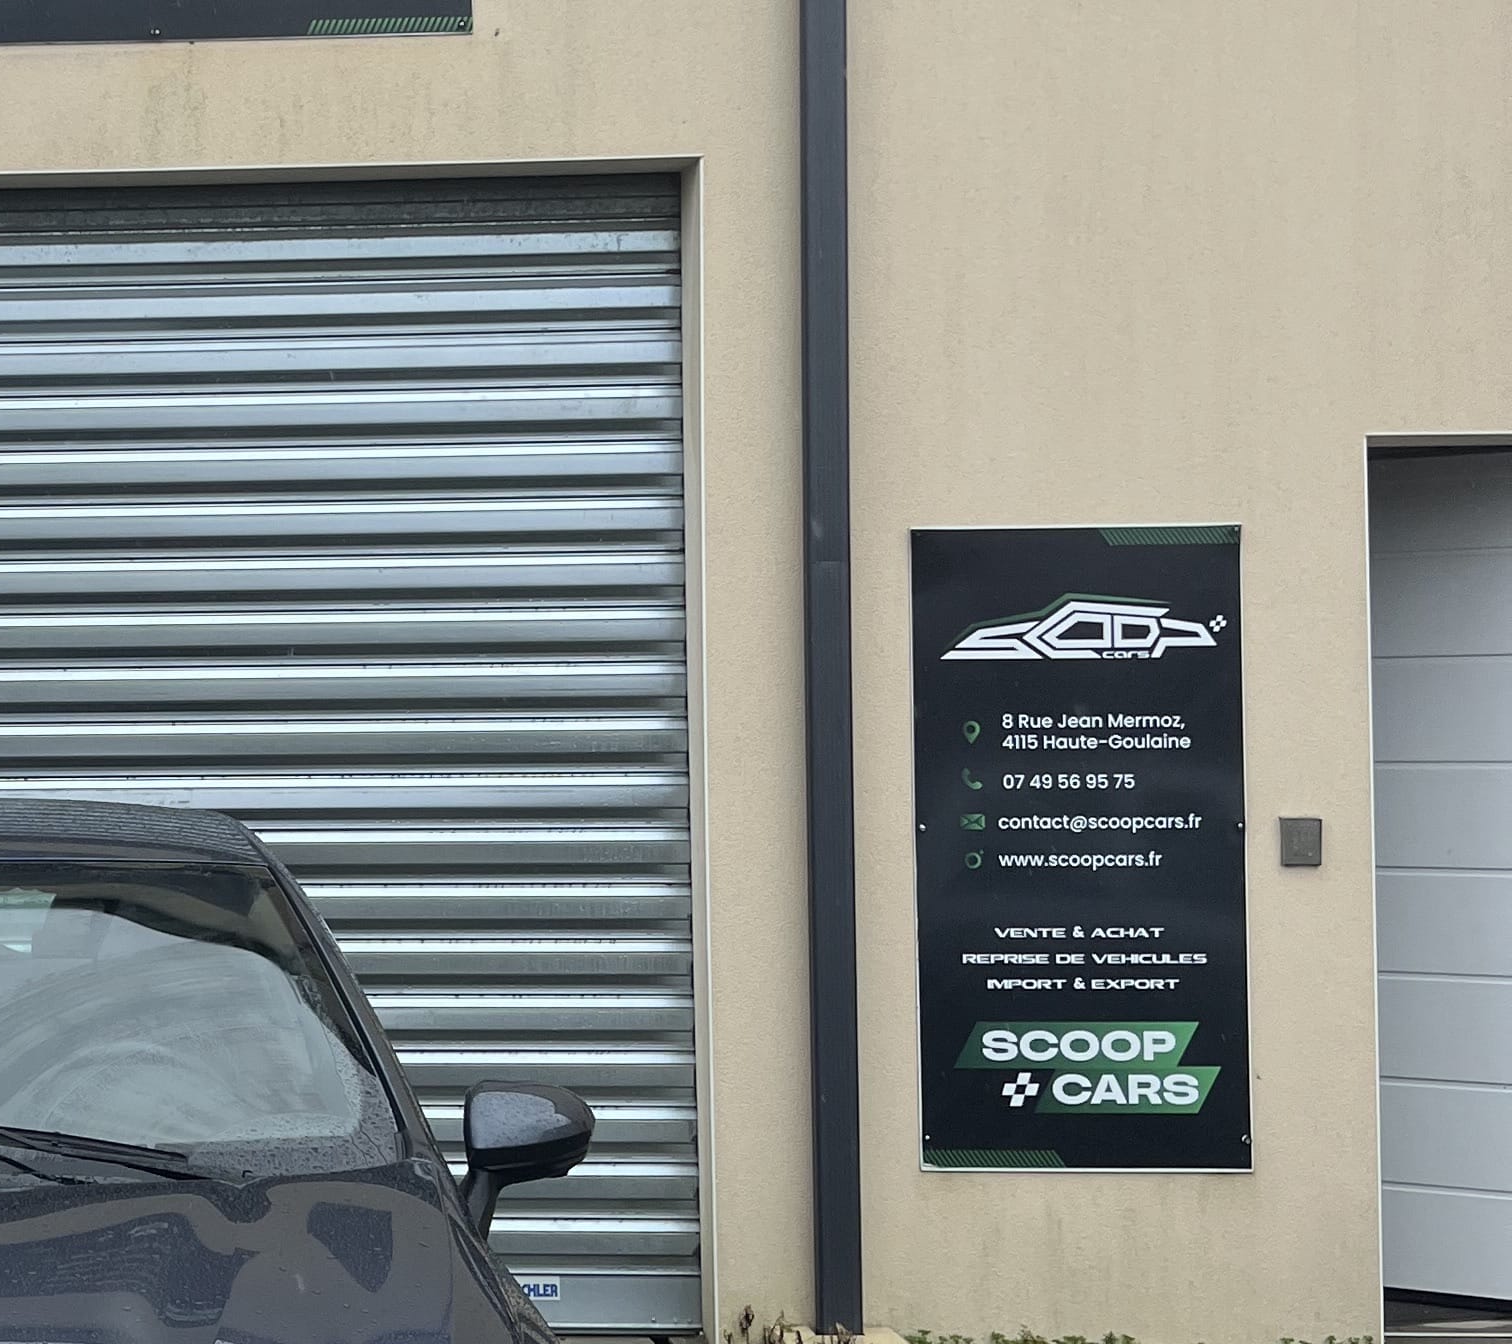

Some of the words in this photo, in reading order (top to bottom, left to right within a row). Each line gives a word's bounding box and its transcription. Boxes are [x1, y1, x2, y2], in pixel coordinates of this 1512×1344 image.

[1100, 650, 1150, 660] cars
[1001, 713, 1014, 729] 8
[1018, 714, 1054, 729] Rue
[1057, 713, 1103, 729] Jean
[1107, 713, 1186, 730] Mermoz,
[1002, 734, 1039, 750] 4115
[1043, 732, 1192, 750] Haute-Goulaine
[1002, 774, 1025, 790] 07
[1029, 773, 1053, 789] 49
[1057, 773, 1081, 789] 56
[1085, 773, 1109, 789] 95
[1113, 773, 1136, 789] 75
[998, 812, 1202, 834] contact@scoopcars.fr
[998, 850, 1163, 871] www.scoopcars.fr
[994, 927, 1067, 939] VENTE
[1072, 925, 1085, 938] &
[1090, 927, 1165, 938] ACHAT
[962, 953, 1050, 965] REPRISE
[1055, 953, 1085, 965] DE
[1091, 953, 1208, 965] VEHICULES
[986, 978, 1067, 990] IMPORT
[1073, 976, 1086, 990] &
[1090, 978, 1180, 990] EXPORT
[982, 1030, 1176, 1062] SCOOP
[1052, 1073, 1200, 1105] CARS
